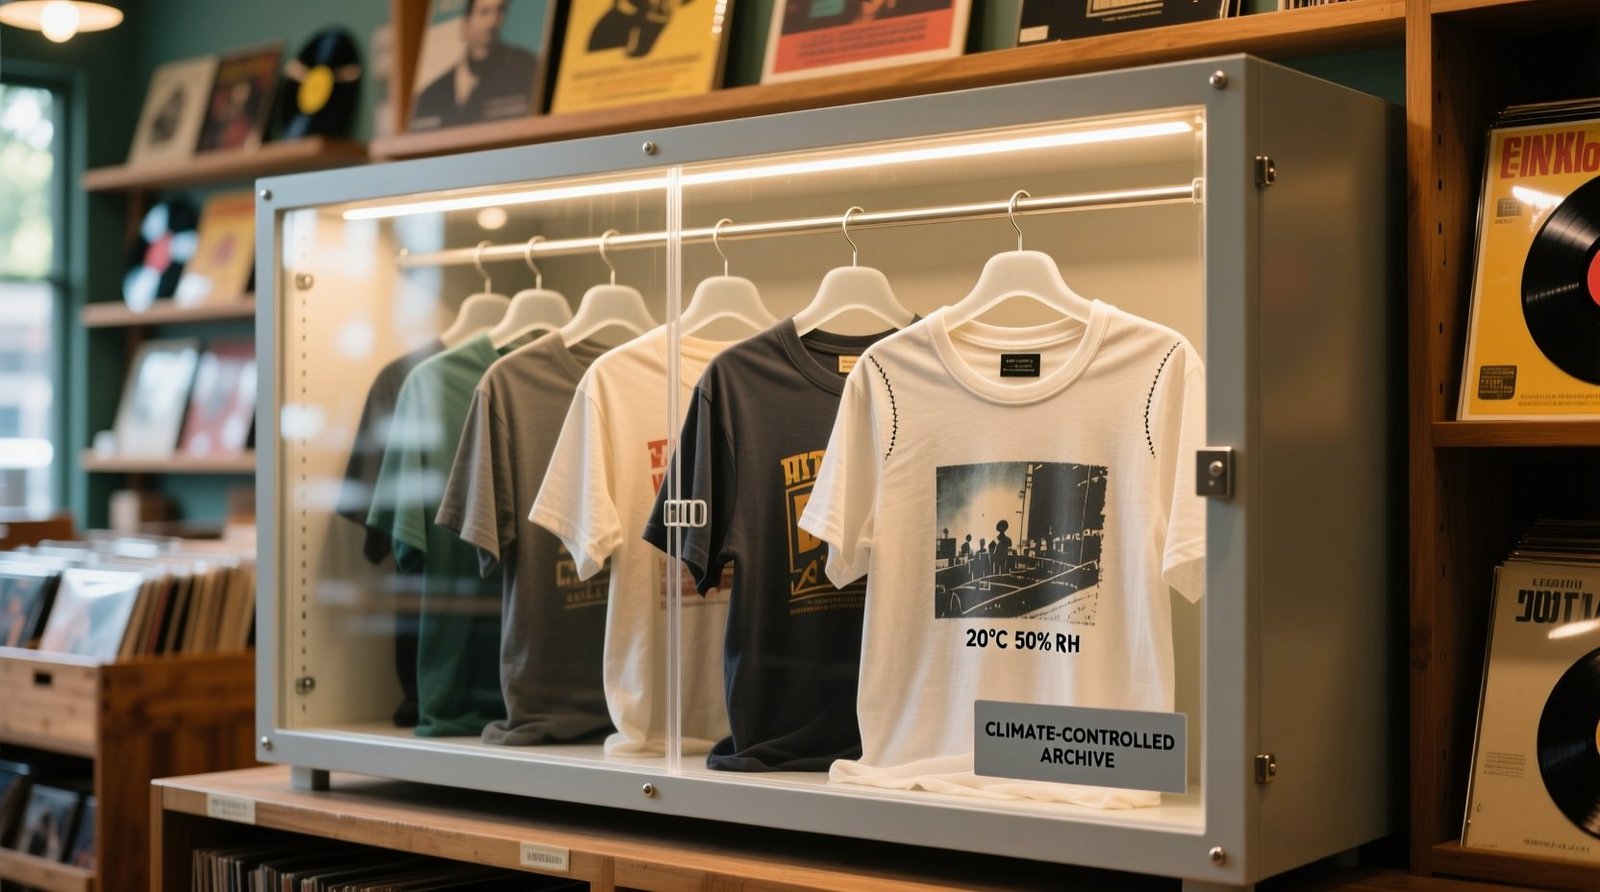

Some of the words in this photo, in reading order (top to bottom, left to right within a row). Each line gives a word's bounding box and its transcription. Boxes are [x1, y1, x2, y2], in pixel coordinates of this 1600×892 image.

[966, 628, 1008, 649] 20°C
[1015, 630, 1051, 651] 50%
[1056, 633, 1080, 653] RH
[985, 721, 1175, 751] CLIMATE-CONTROLLED
[1040, 747, 1115, 768] ARCHIVE
